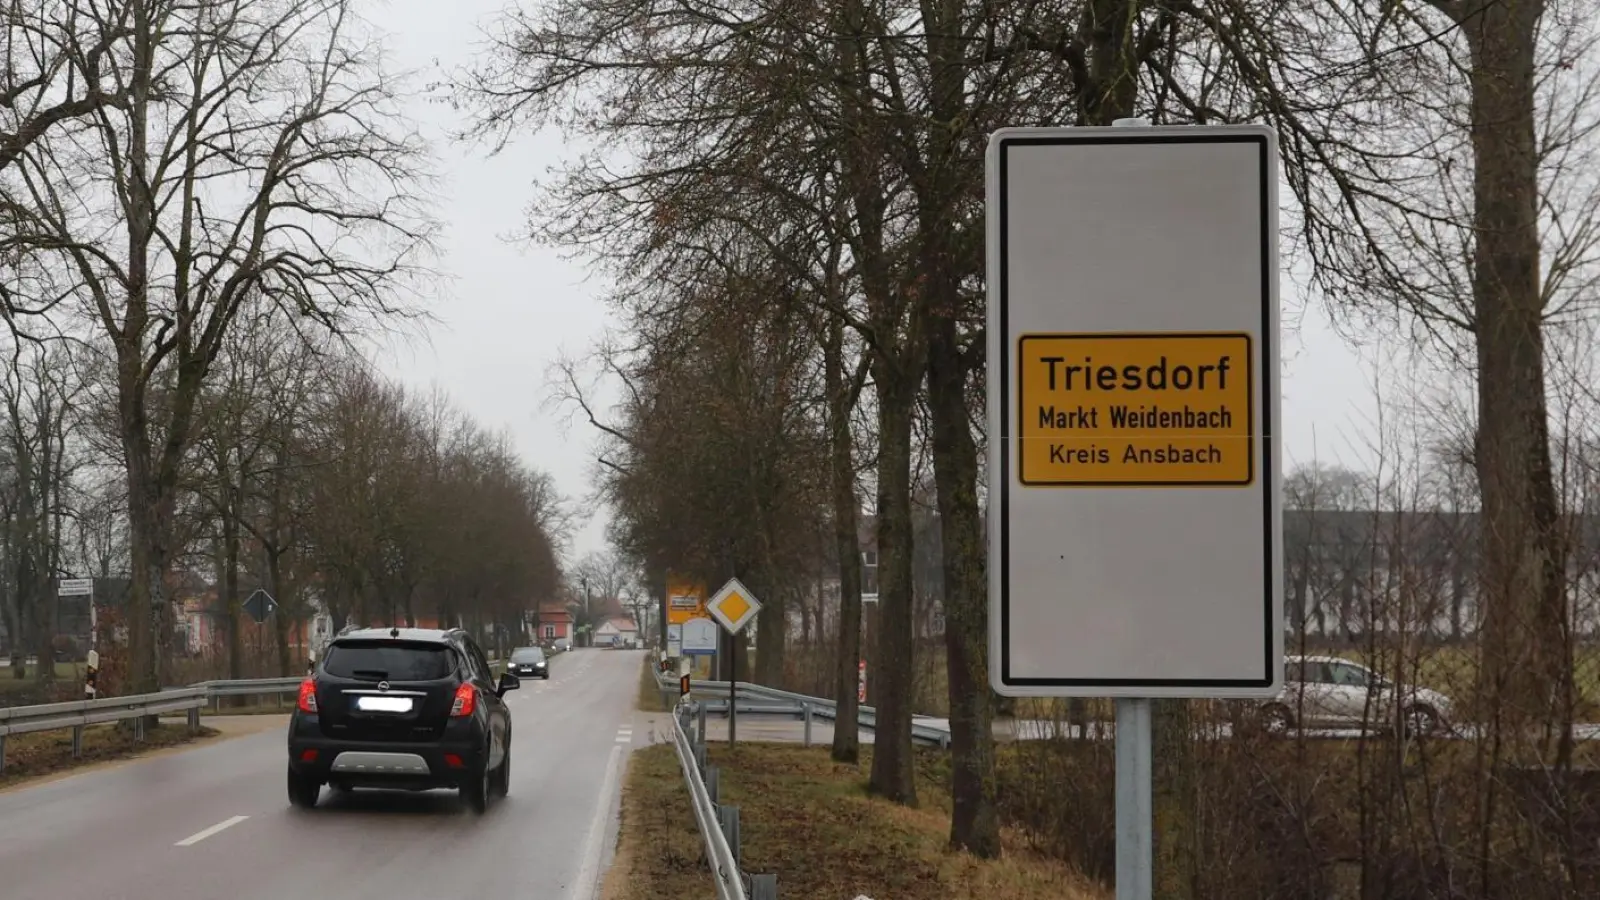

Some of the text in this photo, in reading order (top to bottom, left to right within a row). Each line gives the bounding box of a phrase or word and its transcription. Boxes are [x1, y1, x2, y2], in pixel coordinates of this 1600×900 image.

[1040, 356, 1231, 391] Triesdorf
[1038, 405, 1232, 429] Markt Weidenbach
[1049, 444, 1222, 464] Kreis Ansbach
